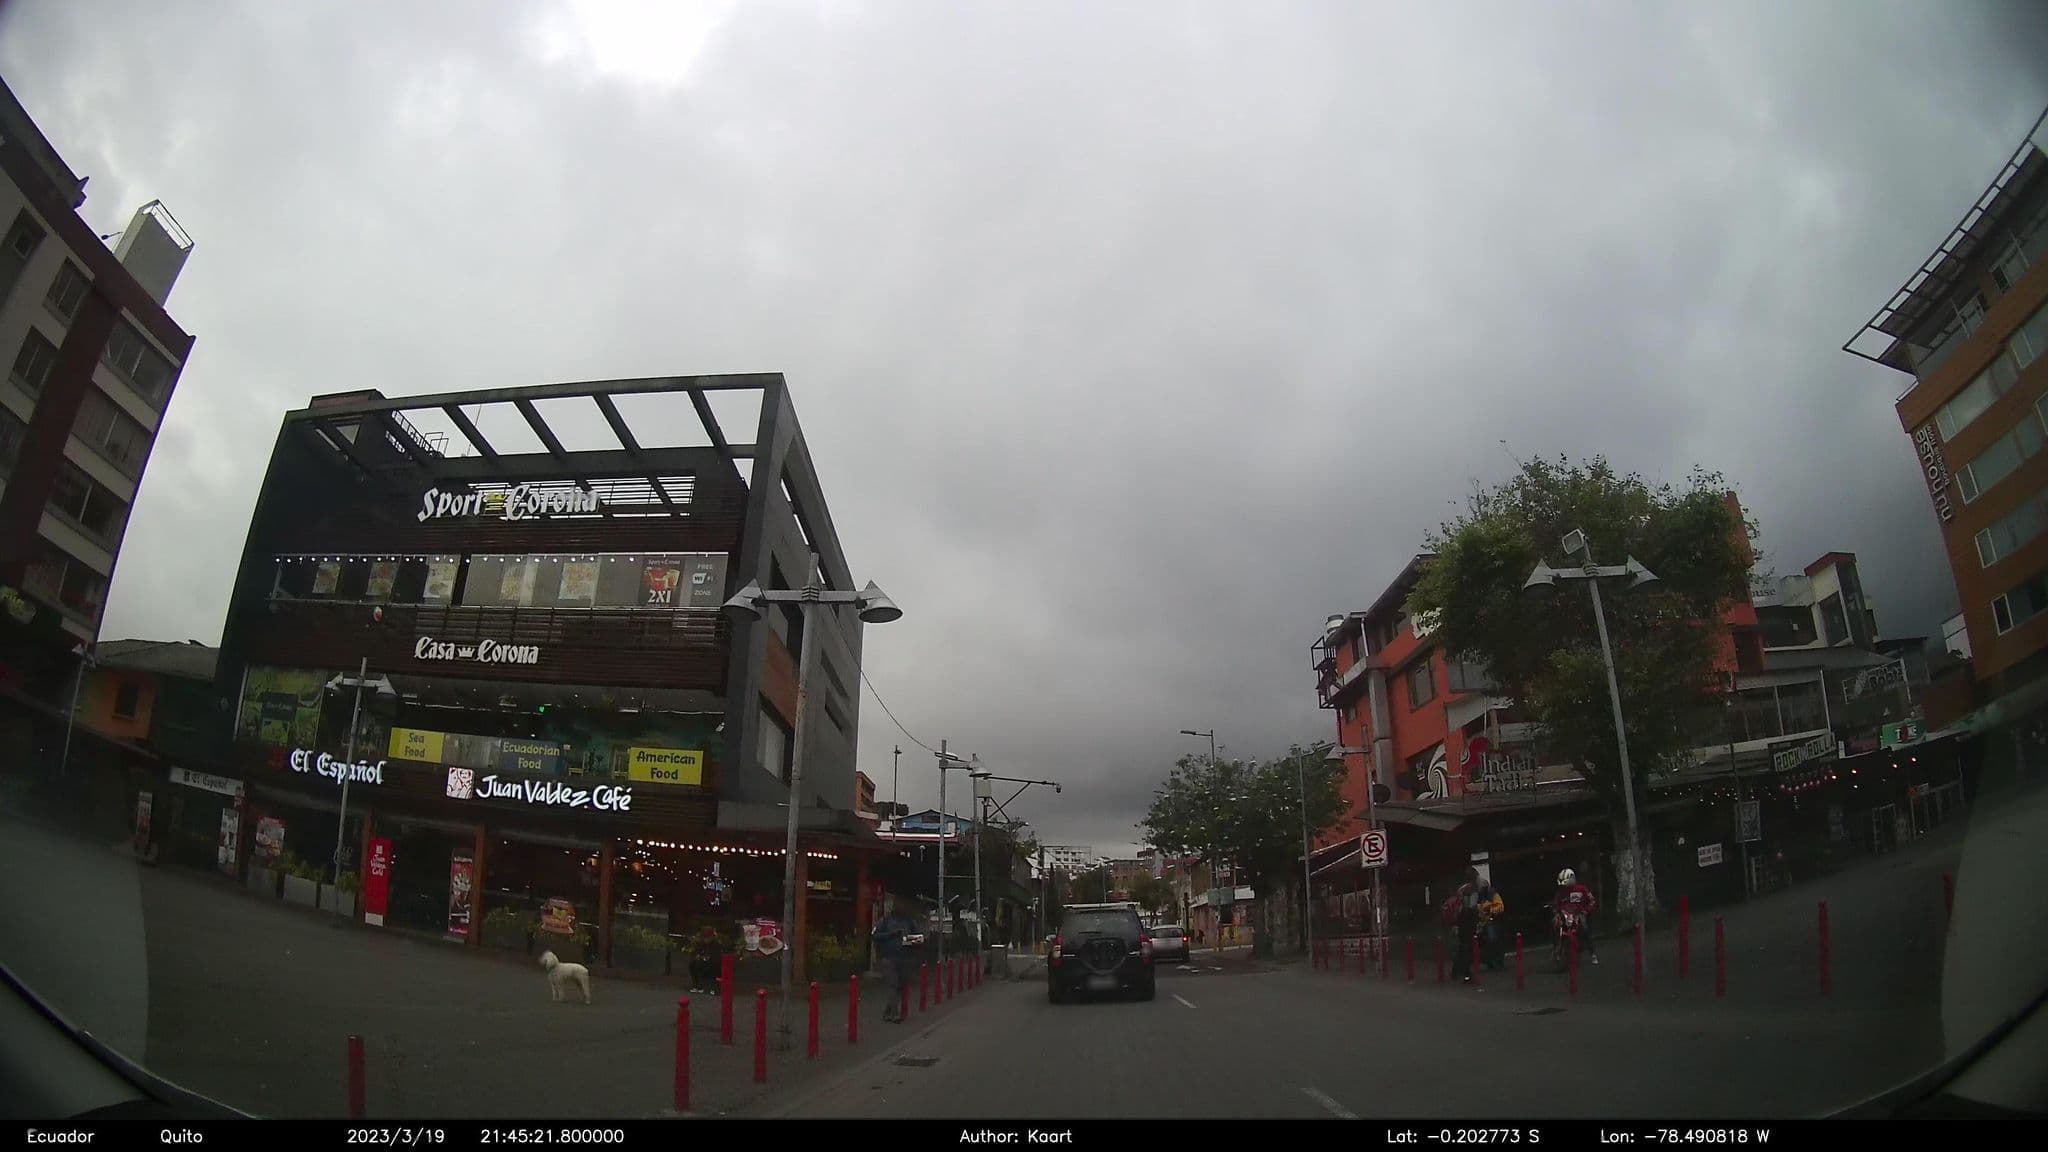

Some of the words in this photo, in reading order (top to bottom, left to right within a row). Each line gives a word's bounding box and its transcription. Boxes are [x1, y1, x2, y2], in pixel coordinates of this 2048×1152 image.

[1916, 429, 1943, 495] house
[417, 487, 483, 522] Sport
[504, 484, 600, 521] Corona
[414, 636, 455, 660] Casa
[474, 639, 539, 665] Corona
[408, 732, 425, 744] Sea
[404, 746, 426, 759] Food
[503, 741, 560, 757] Ecuadorian
[290, 748, 313, 773] El
[316, 752, 387, 786] Español
[518, 757, 542, 770] Food
[637, 751, 696, 766] American
[1480, 752, 1536, 772] Indian
[650, 768, 679, 781] Food
[475, 774, 522, 800] Juan
[592, 785, 632, 811] Café
